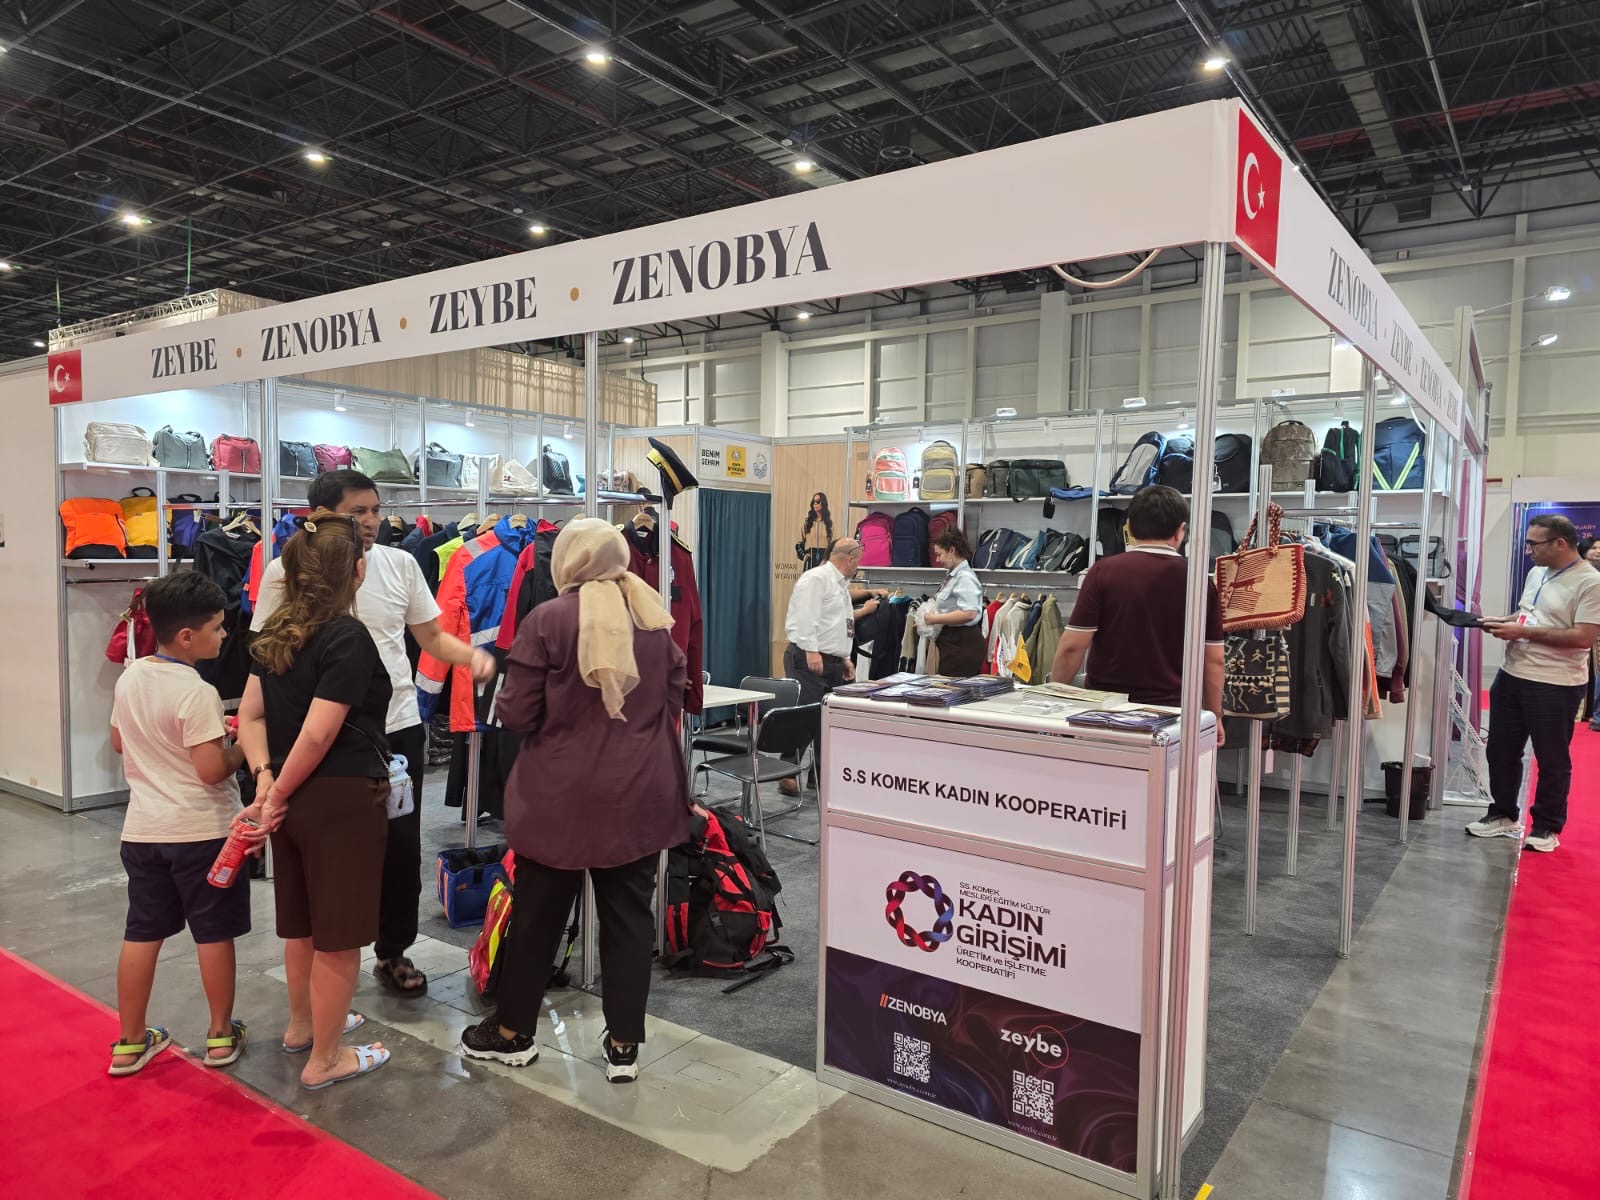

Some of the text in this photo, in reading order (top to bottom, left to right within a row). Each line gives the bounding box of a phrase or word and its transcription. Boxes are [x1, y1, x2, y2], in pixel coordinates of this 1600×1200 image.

[151, 221, 832, 379] ZEYBE ZENOBYA ZEYBE ZENOBYA
[1328, 247, 1378, 341] ZENOBYA
[1391, 319, 1414, 377] ZEYBE
[775, 561, 798, 570] WOMAN
[842, 767, 1127, 830] S.S KOMEK KADIN KOOPERATİFİ
[973, 885, 1000, 896] KOMEK
[959, 898, 1043, 936] KADIN
[1020, 902, 1051, 915] KÜLTÜR
[956, 946, 1047, 977] ÜRETİM ve İŞLETME
[957, 923, 1066, 969] GİRİŞİMİ
[956, 957, 1016, 980] KOOPERATİFİ
[1001, 1029, 1062, 1057] zeybe
